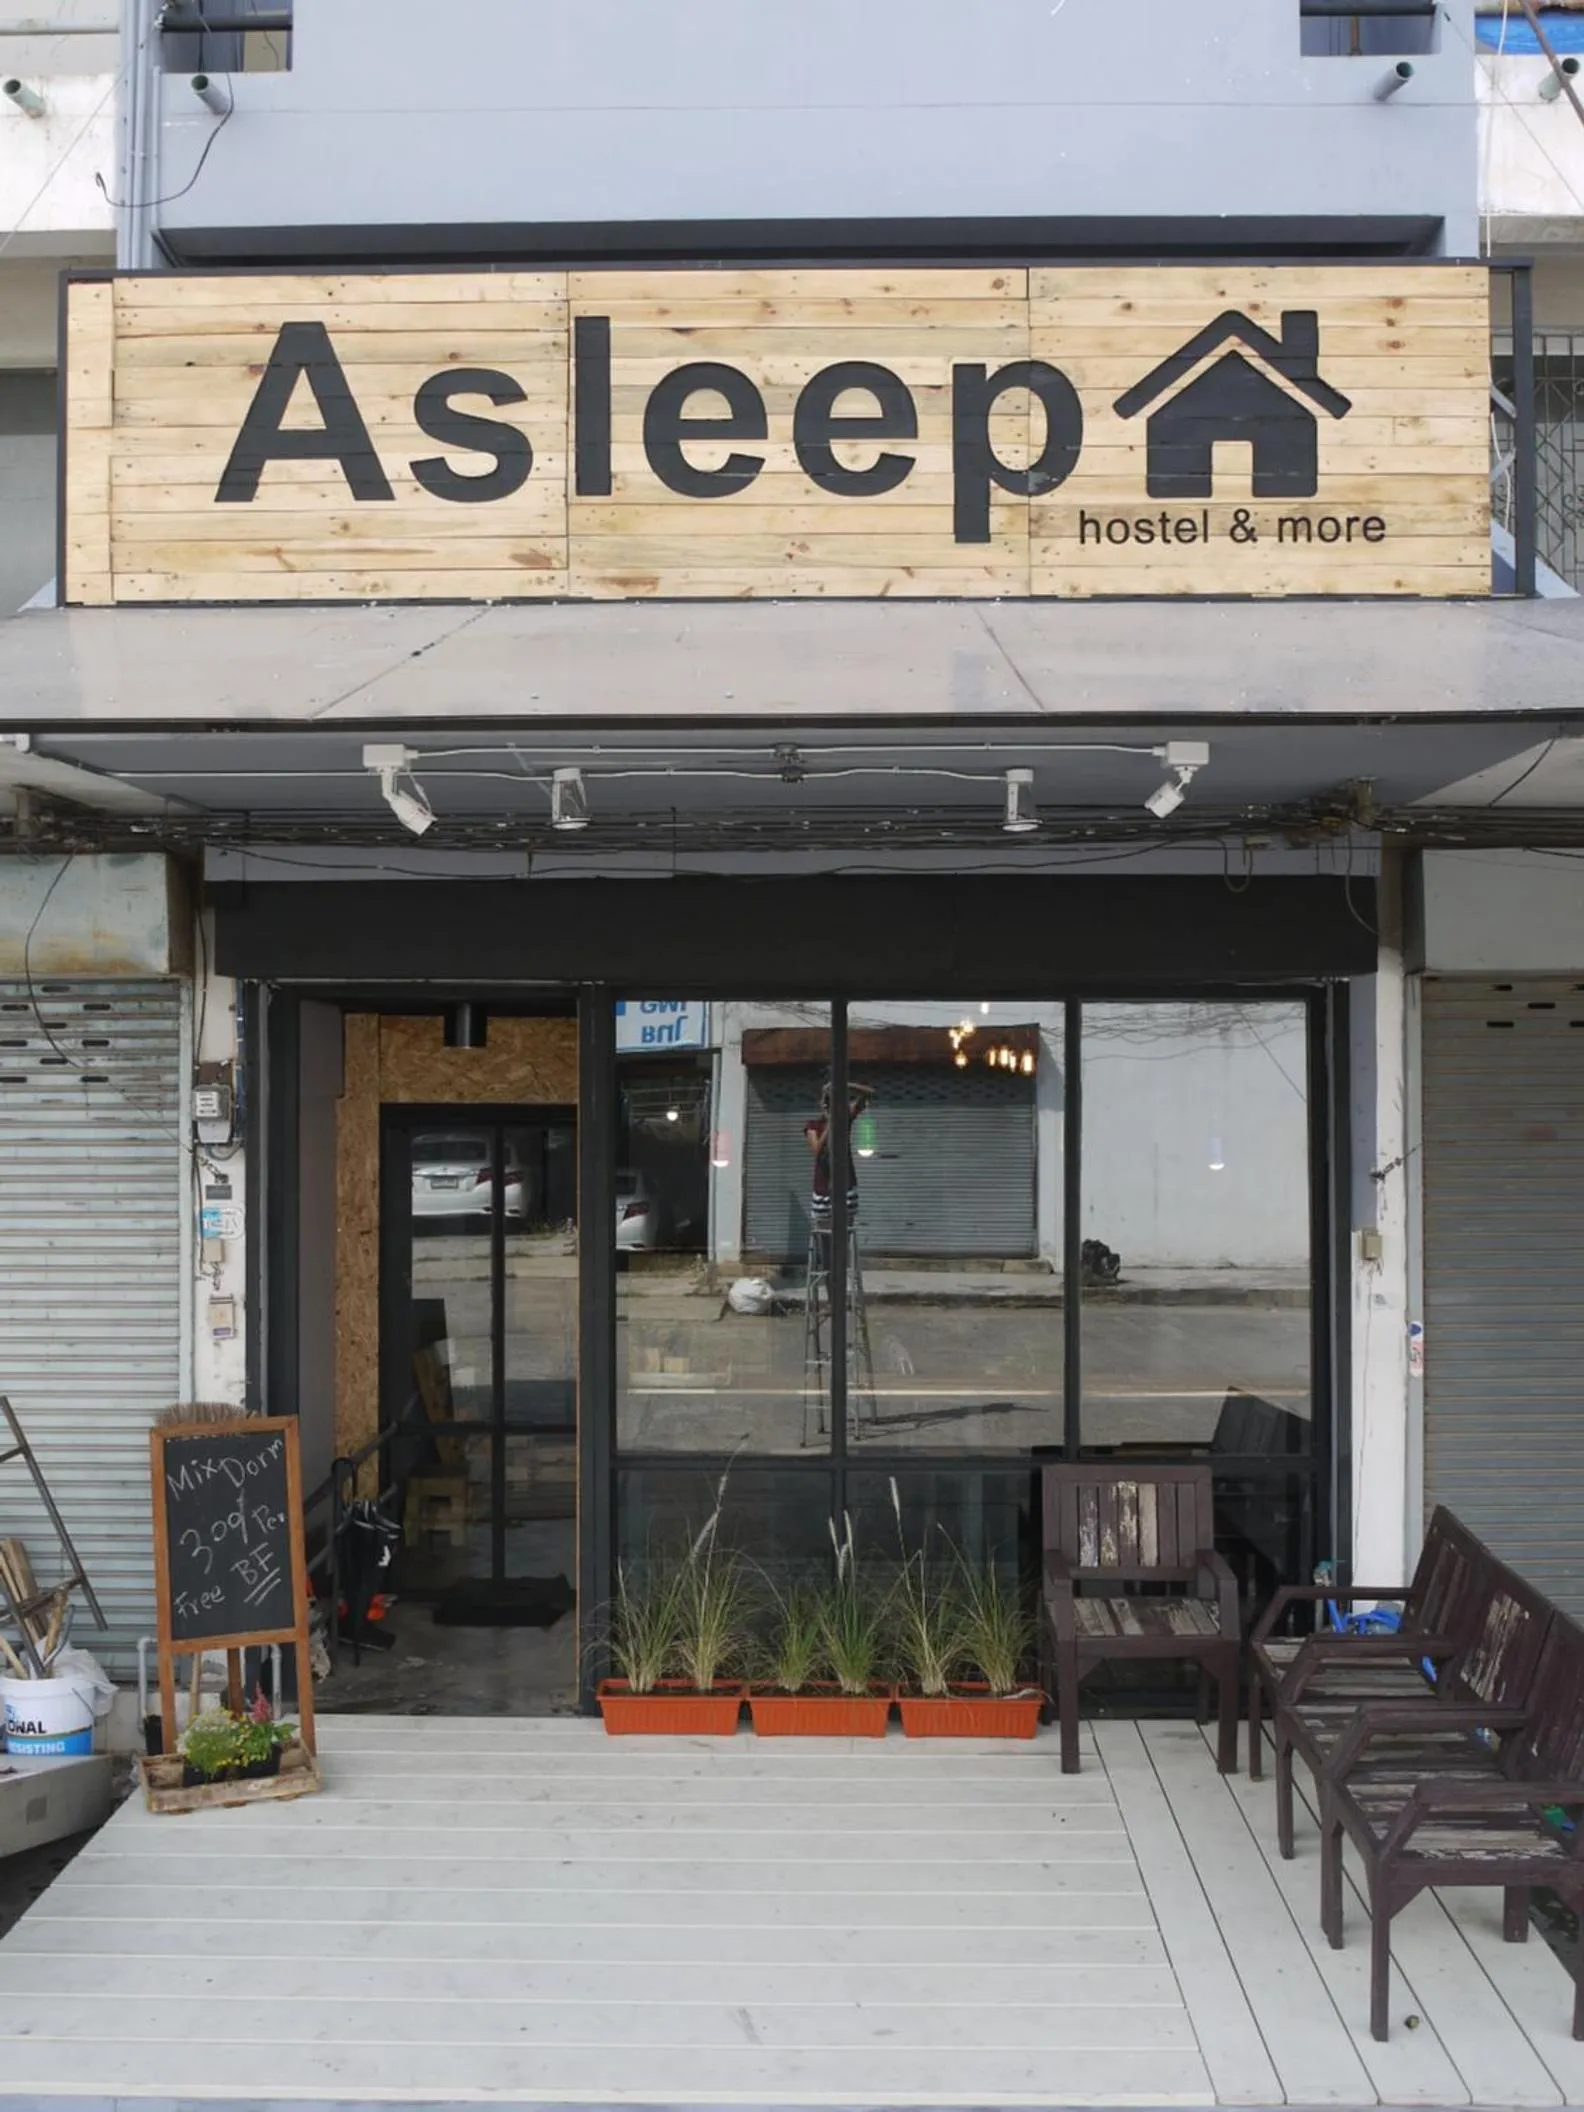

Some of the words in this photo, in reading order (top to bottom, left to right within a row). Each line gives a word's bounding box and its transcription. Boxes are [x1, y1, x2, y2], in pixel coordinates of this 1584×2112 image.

[215, 315, 1084, 544] Asleep
[1079, 508, 1209, 546] hostel
[1229, 508, 1258, 544] &
[1278, 515, 1387, 544] more
[217, 1438, 283, 1489] Dorm
[173, 1584, 226, 1619] Free
[229, 1541, 275, 1586] BF
